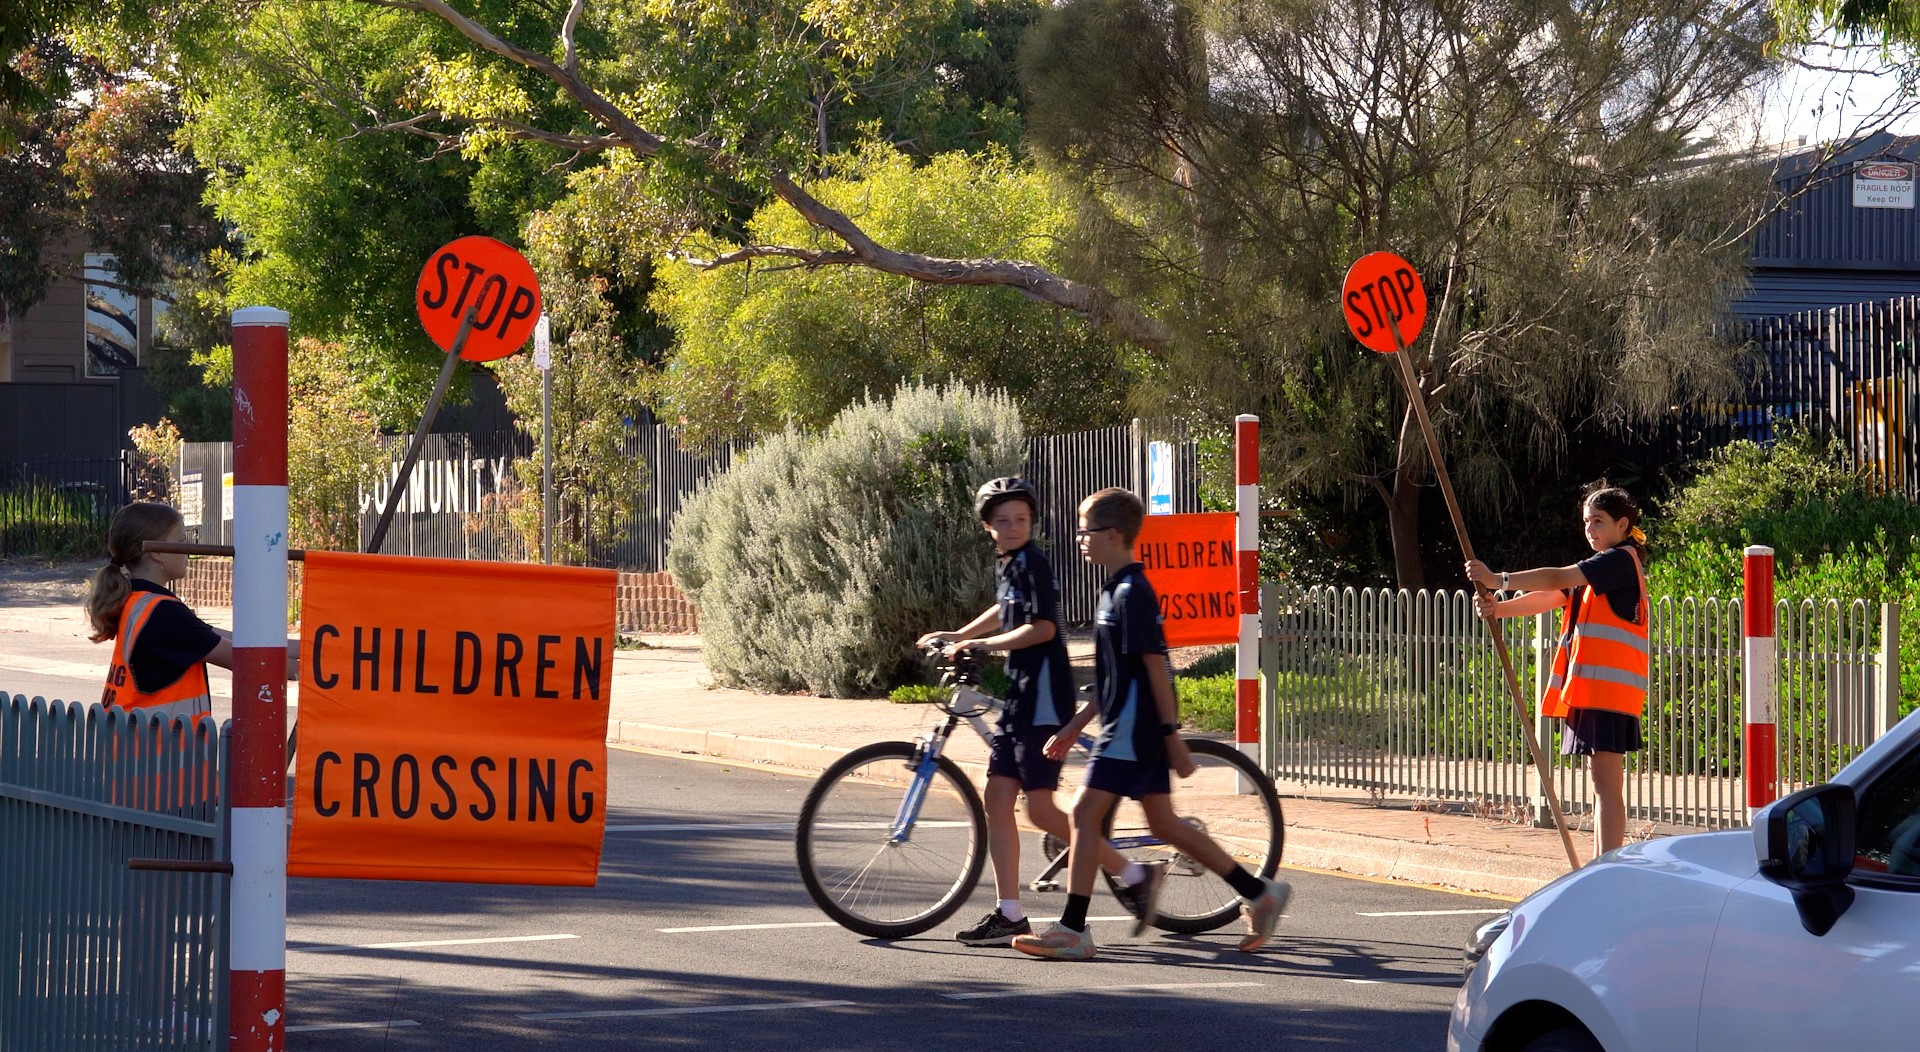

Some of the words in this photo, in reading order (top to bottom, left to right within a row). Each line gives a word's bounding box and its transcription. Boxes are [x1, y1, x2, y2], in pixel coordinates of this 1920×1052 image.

[1867, 168, 1901, 177] DANGER
[1856, 184, 1888, 192] FRAGILE
[1890, 185, 1912, 193] ROOF
[1867, 195, 1886, 204] Keep
[1888, 195, 1901, 203] Off
[423, 252, 536, 340] STOP
[1346, 267, 1415, 338] STOP
[1140, 540, 1234, 570] HILDREN
[1159, 591, 1236, 621] OSSING
[312, 624, 603, 701] CHILDREN
[313, 751, 595, 824] CROSSING
